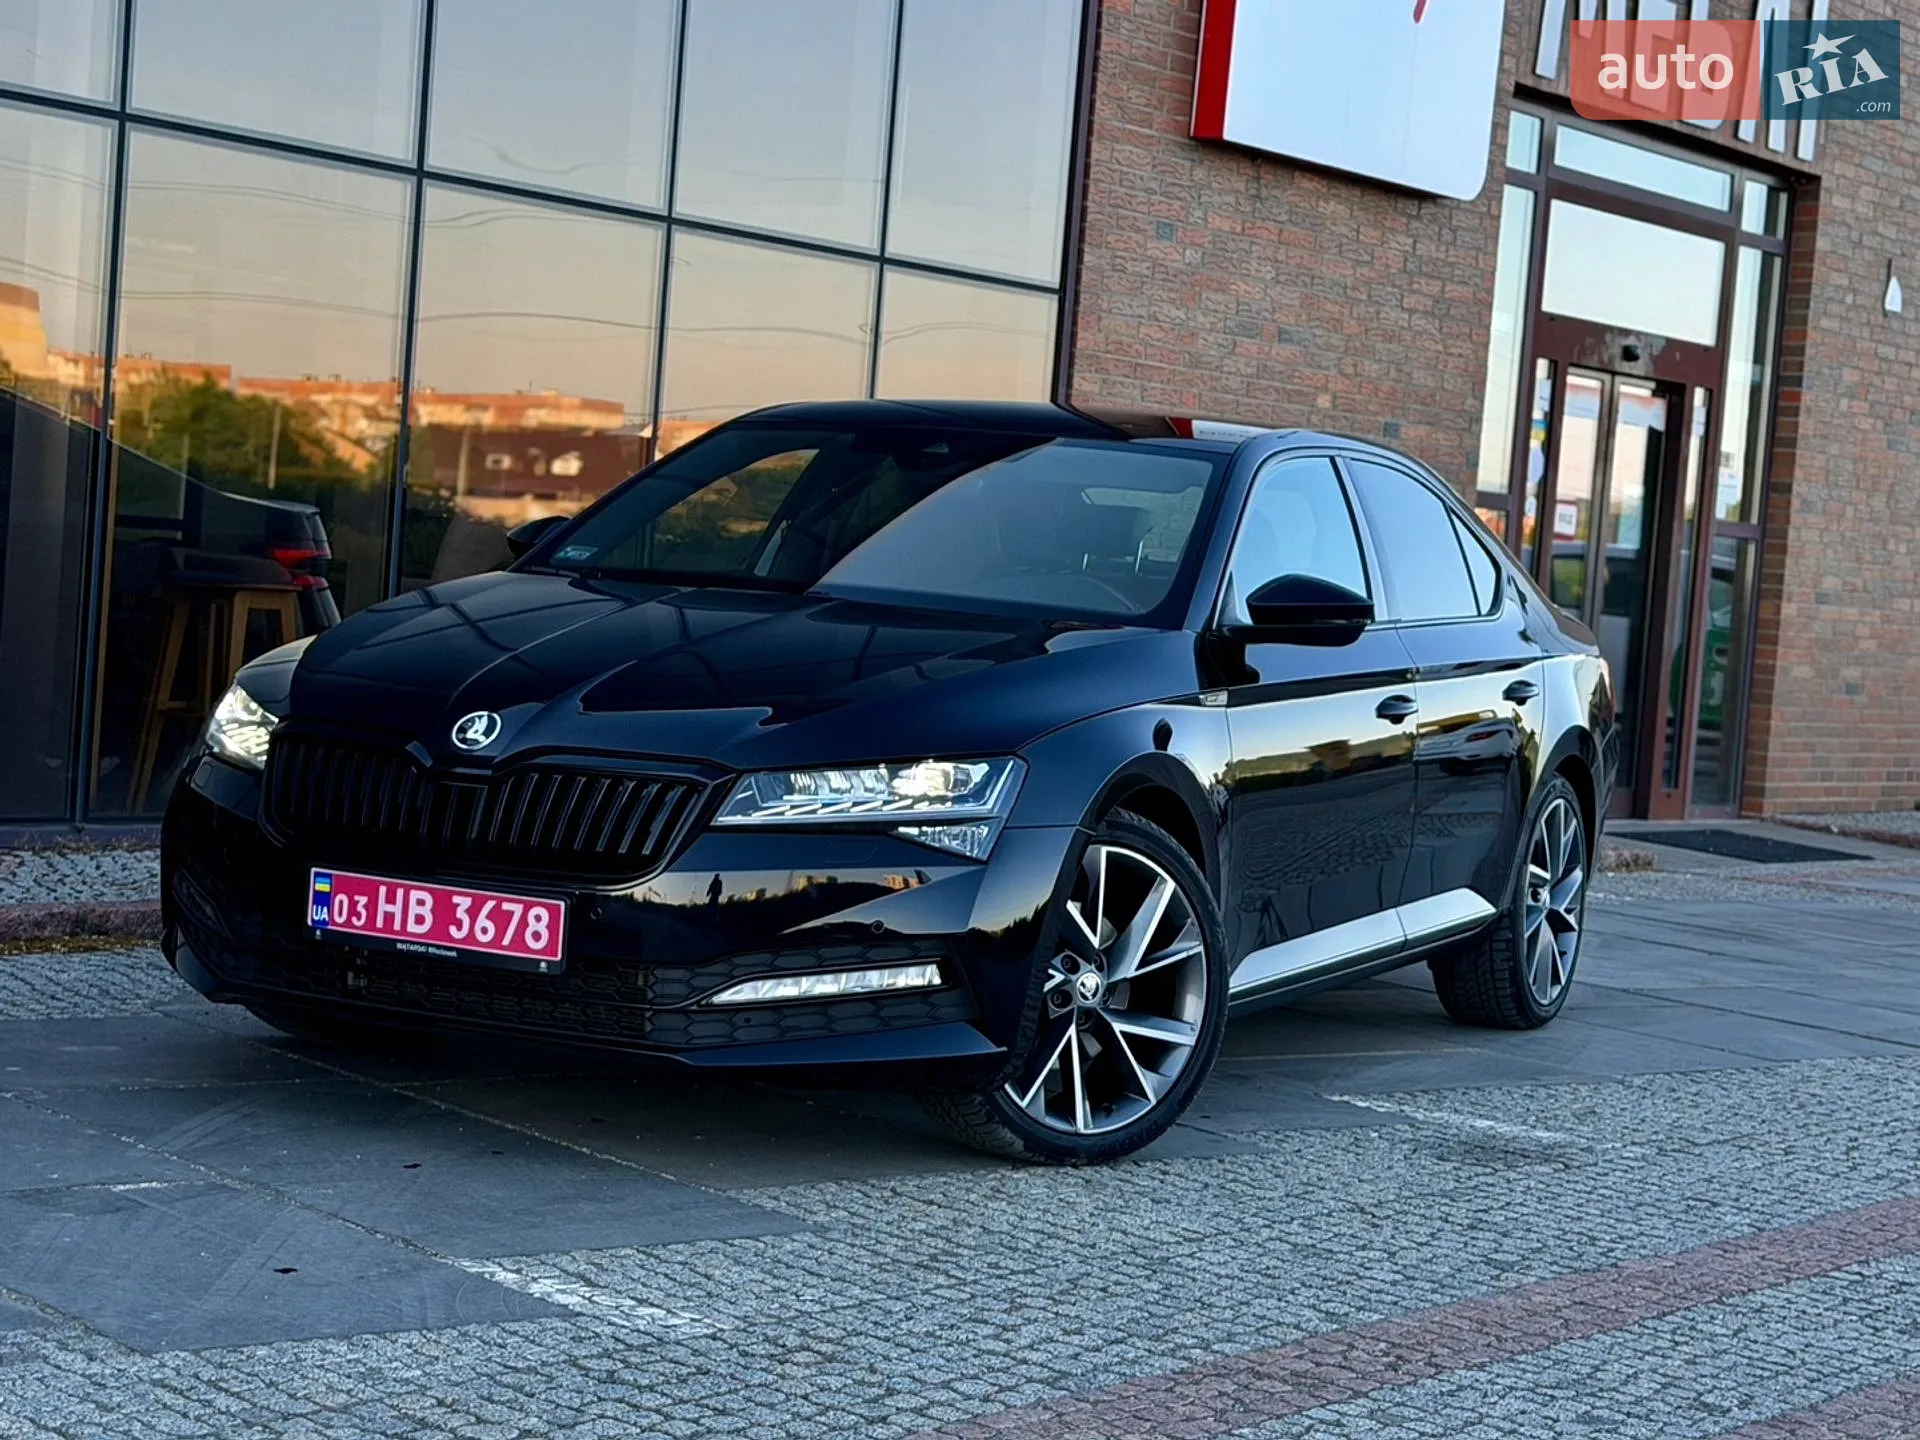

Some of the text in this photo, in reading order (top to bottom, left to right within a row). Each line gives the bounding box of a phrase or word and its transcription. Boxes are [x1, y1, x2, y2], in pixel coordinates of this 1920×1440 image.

[312, 904, 329, 922] UA
[333, 892, 368, 927] 03
[448, 897, 549, 949] 3678
